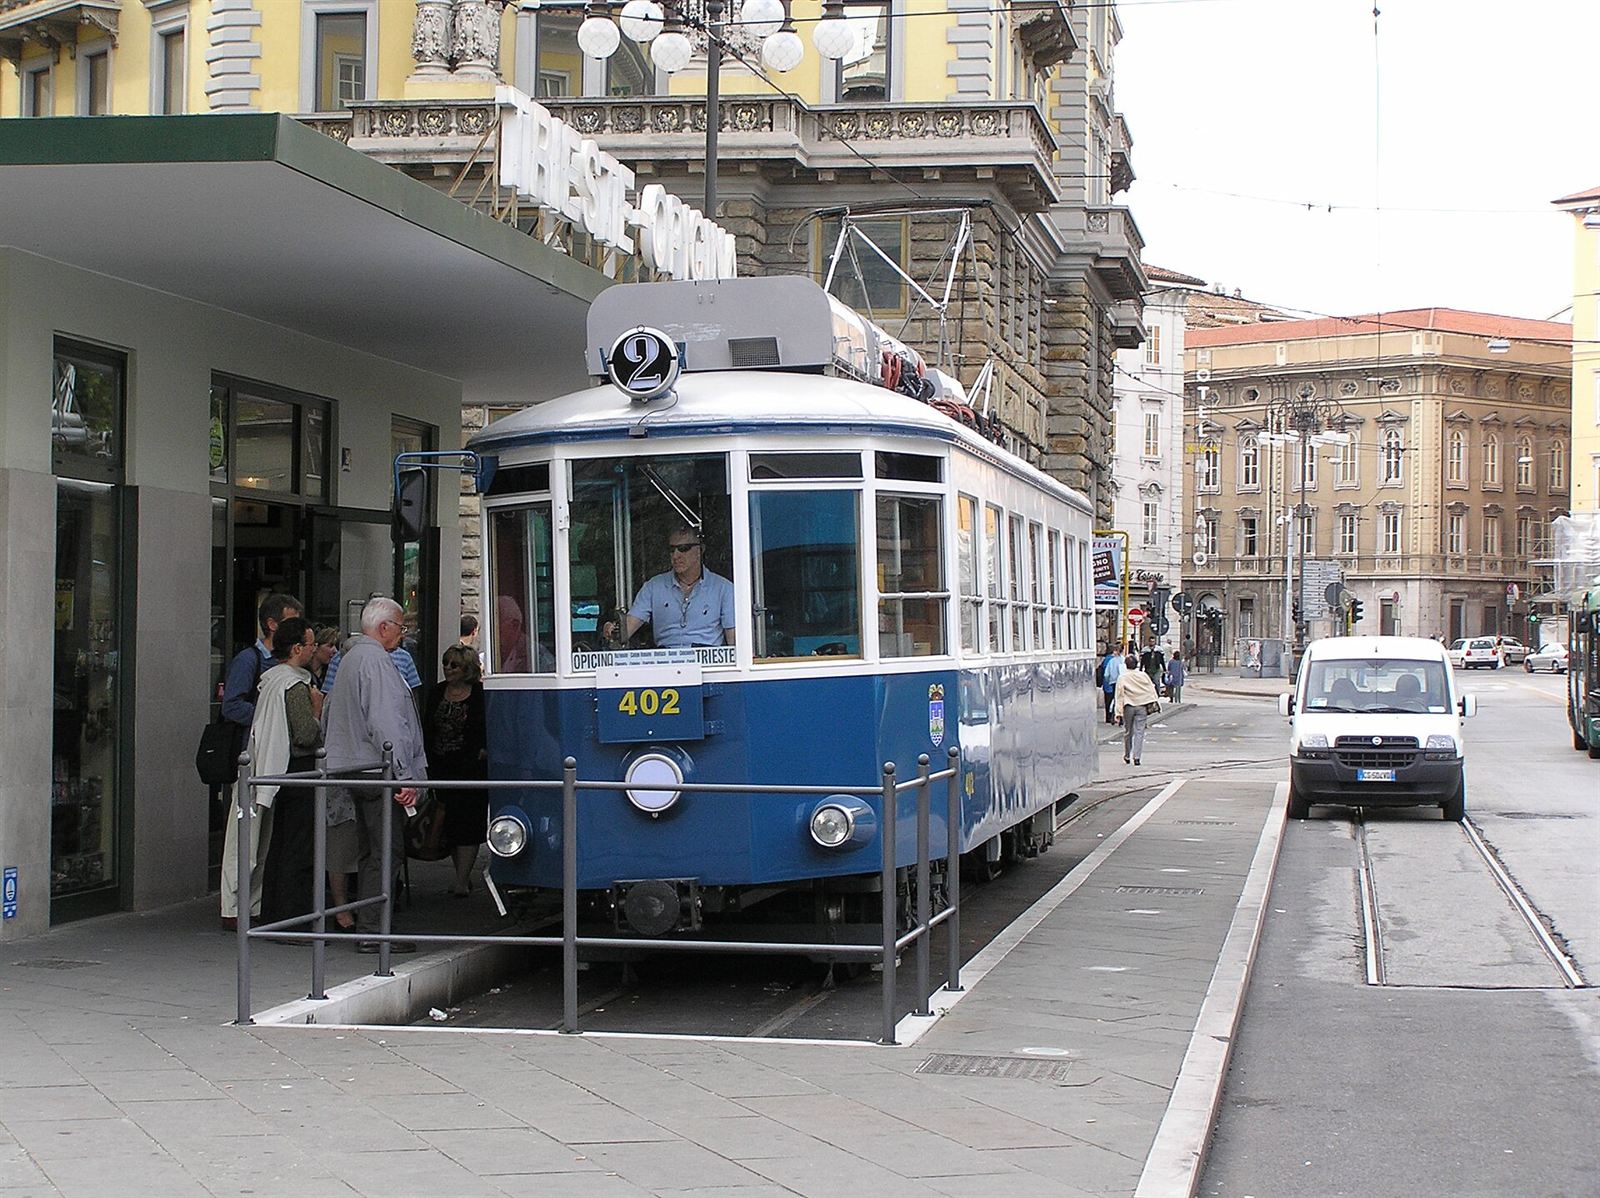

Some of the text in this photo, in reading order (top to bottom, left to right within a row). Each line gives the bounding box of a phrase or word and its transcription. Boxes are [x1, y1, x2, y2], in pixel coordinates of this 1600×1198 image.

[623, 333, 662, 390] 2
[573, 653, 614, 670] OPICINA
[696, 648, 736, 665] TRIESTE
[619, 688, 681, 716] 402
